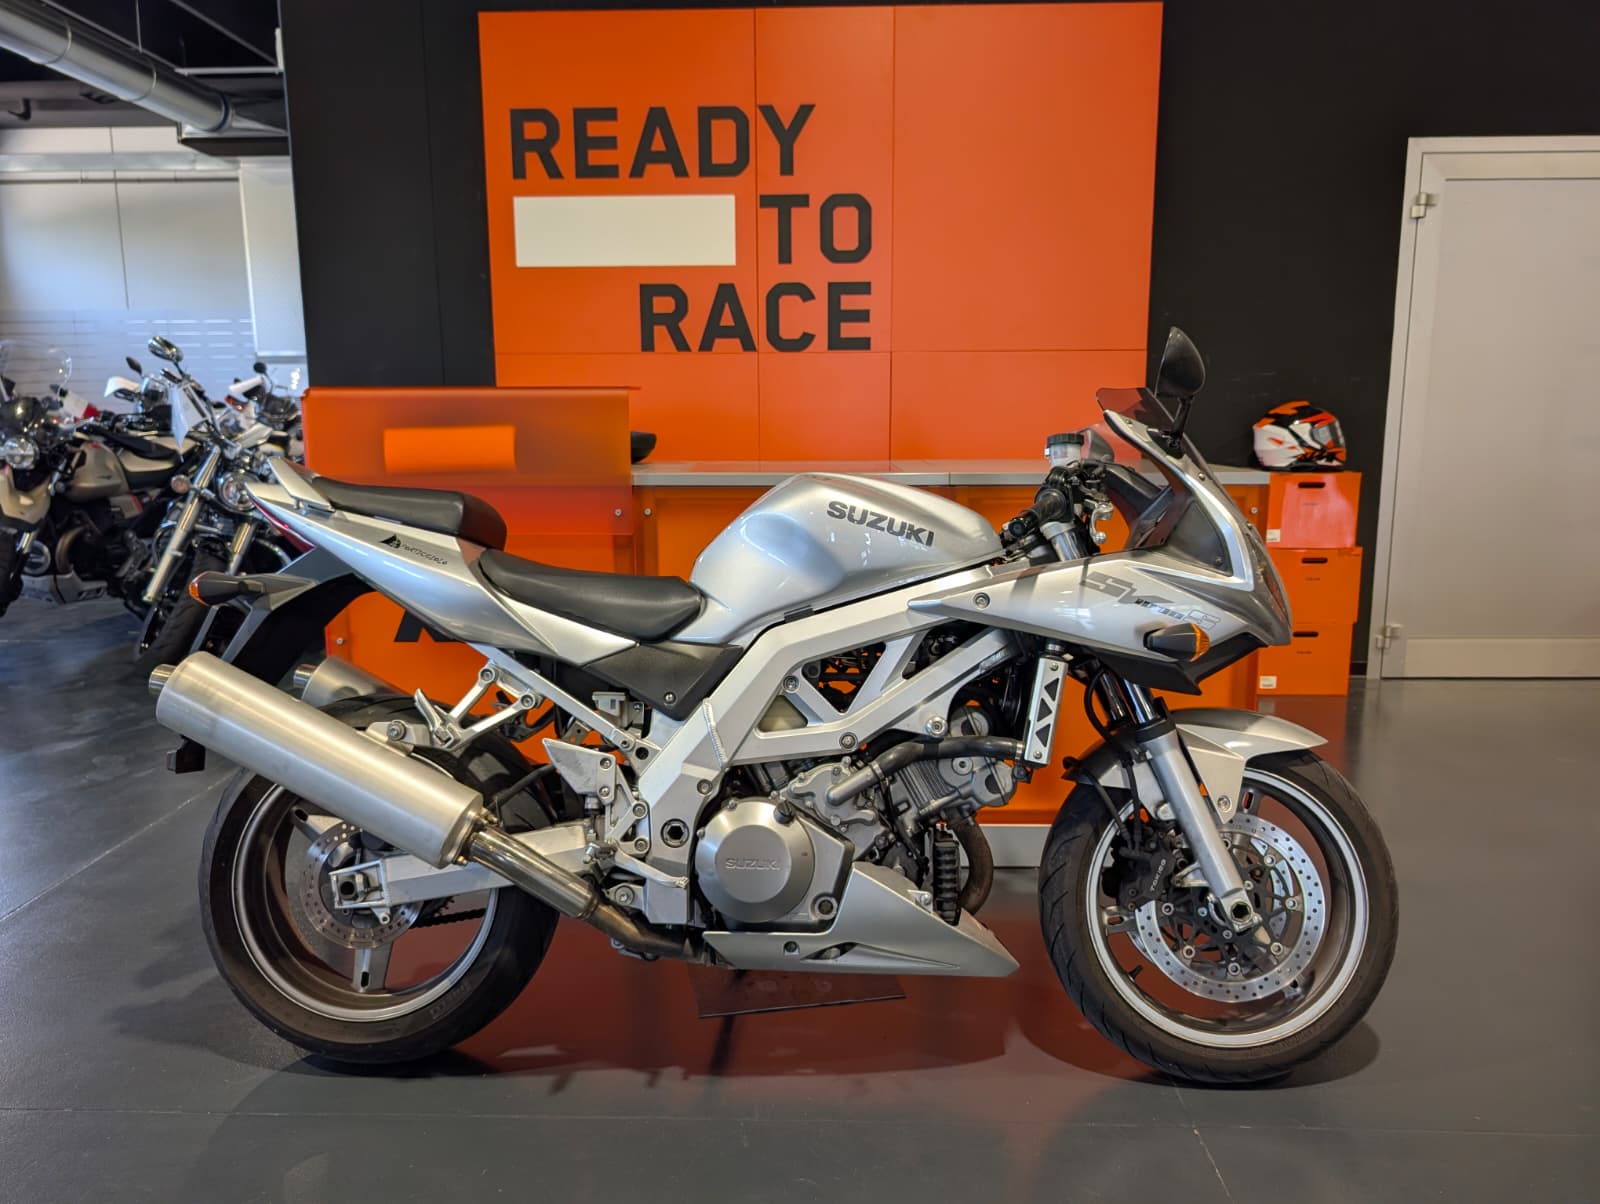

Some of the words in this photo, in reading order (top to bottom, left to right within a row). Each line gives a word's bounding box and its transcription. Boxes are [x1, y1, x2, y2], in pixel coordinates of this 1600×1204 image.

[509, 104, 816, 180] READY
[759, 193, 872, 265] TO
[639, 281, 872, 353] RACE
[826, 500, 935, 547] SUZUKI
[725, 857, 781, 871] SUZUKI
